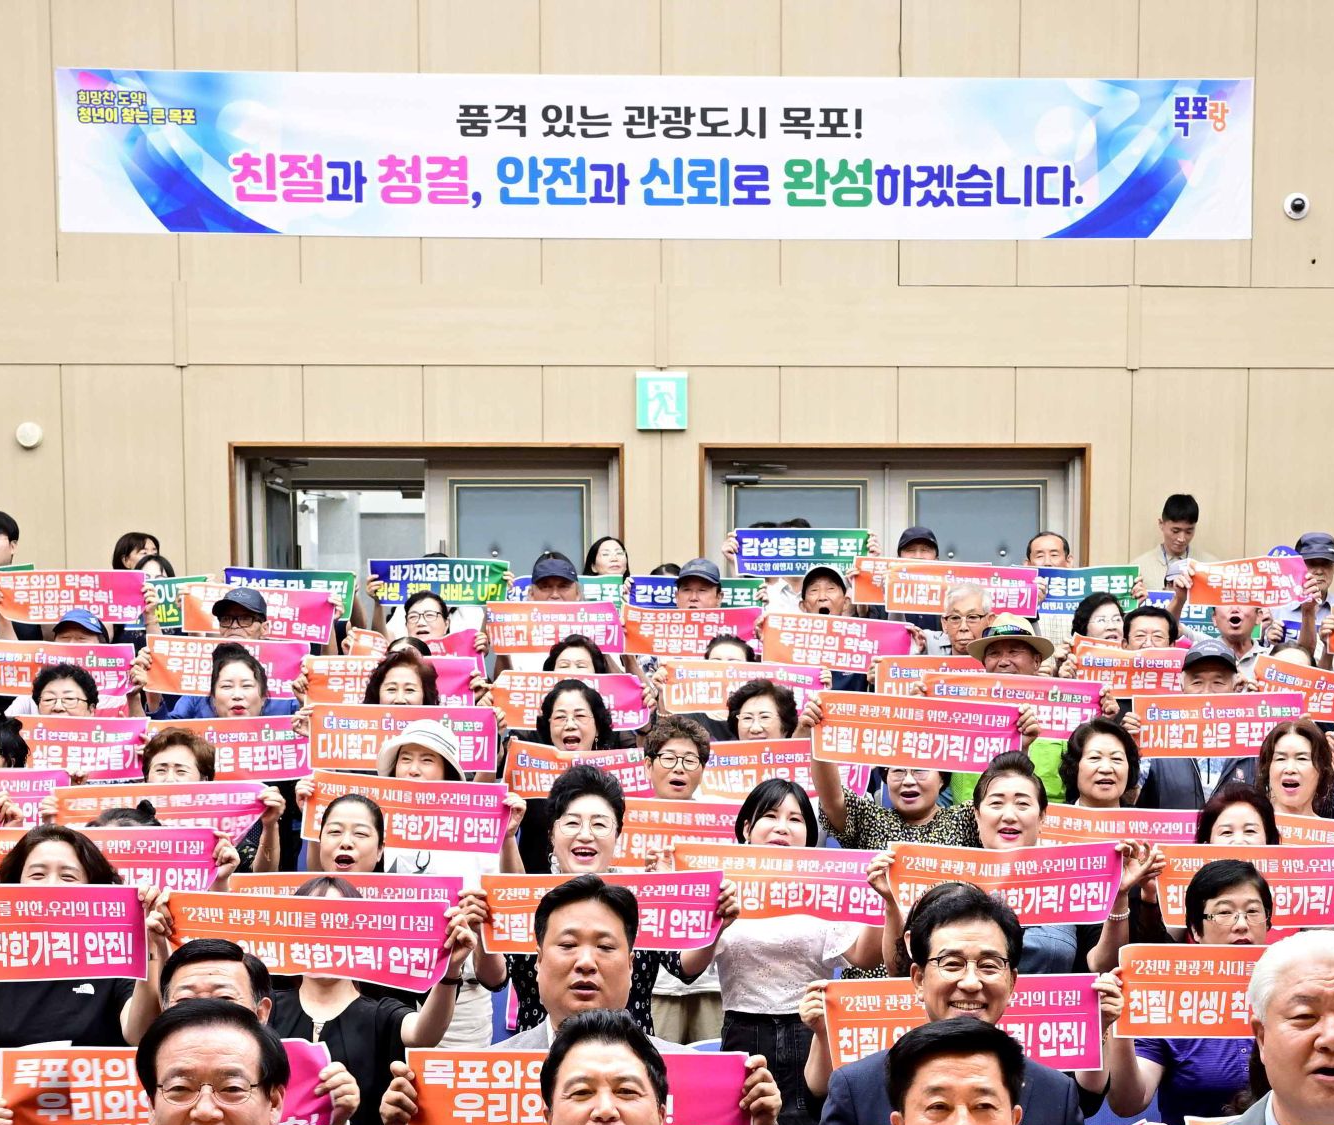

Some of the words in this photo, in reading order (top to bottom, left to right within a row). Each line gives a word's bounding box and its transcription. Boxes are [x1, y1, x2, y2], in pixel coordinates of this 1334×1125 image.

[77, 90, 116, 106] 희망찬
[117, 91, 147, 106] 도약!
[77, 106, 119, 124] 청년이
[121, 107, 149, 125] 찾는
[151, 108, 166, 125] 큰
[168, 108, 197, 125] 목포
[456, 104, 527, 139] 품격
[541, 104, 612, 139] 있는
[622, 104, 767, 139] 관광도시
[779, 106, 863, 139] 목포!
[1174, 97, 1229, 137] 목포랑
[231, 153, 368, 204] 친절과
[377, 154, 483, 208] 청결,
[496, 156, 630, 206] 안전과
[640, 156, 770, 207] 신뢰로
[783, 157, 1085, 208] 완성하겠습니다.
[742, 537, 816, 557] 감성충만
[821, 537, 862, 557] 목포!
[390, 564, 450, 581] 바가지요금
[454, 565, 490, 582] OUT!
[822, 726, 857, 752] 친절!
[862, 730, 898, 755] 위생!
[903, 733, 970, 761] 착한가격!
[93, 901, 125, 918] 다짐!
[228, 909, 270, 926] 관광객
[274, 911, 316, 928] 시대를
[400, 915, 433, 932] 다짐!
[84, 931, 132, 964] 안전!
[290, 942, 382, 970] 착한가격!
[388, 947, 438, 979] 안전!
